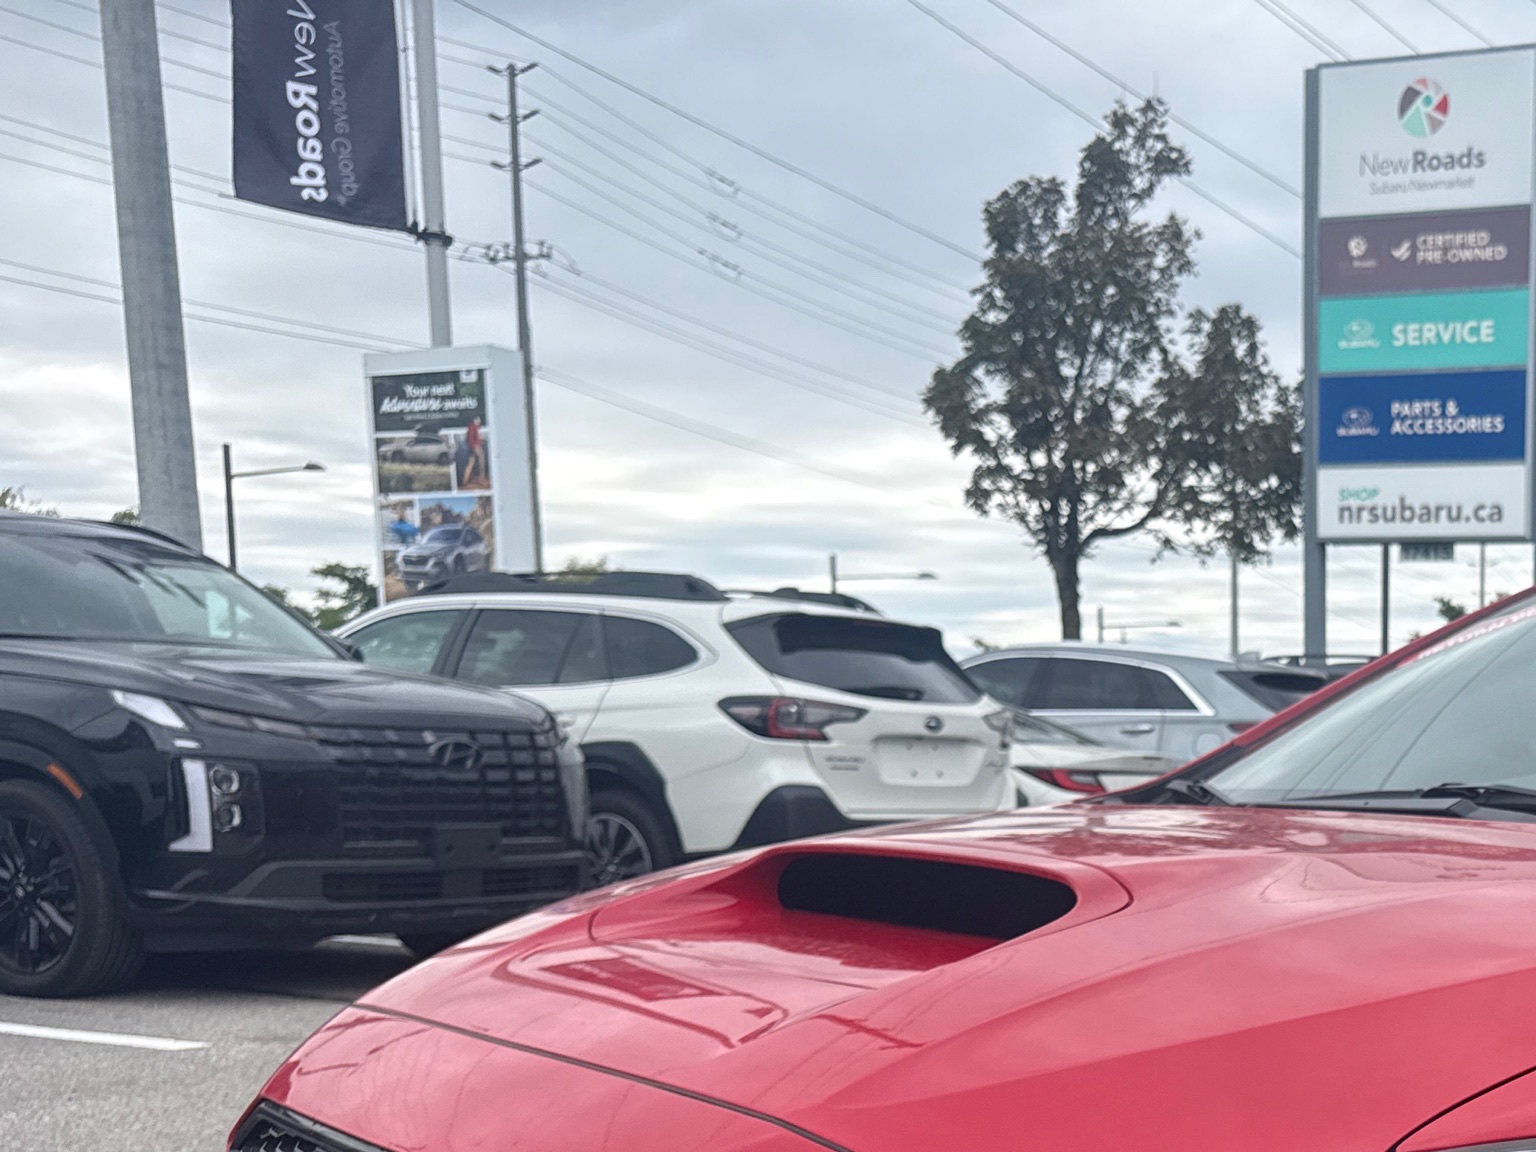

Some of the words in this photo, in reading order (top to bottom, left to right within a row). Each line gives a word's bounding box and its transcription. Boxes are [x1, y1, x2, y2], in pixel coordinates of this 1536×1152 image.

[1416, 230, 1490, 248] CERTIFIED
[1416, 245, 1508, 264] PRE-OWNED
[1391, 320, 1496, 347] SERVICE
[1391, 402, 1441, 417] PARTS
[1445, 399, 1459, 416] &
[1390, 414, 1505, 436] ACCESSORIES
[1338, 487, 1381, 502] SHOP
[1337, 496, 1504, 526] nrsubaru.ca
